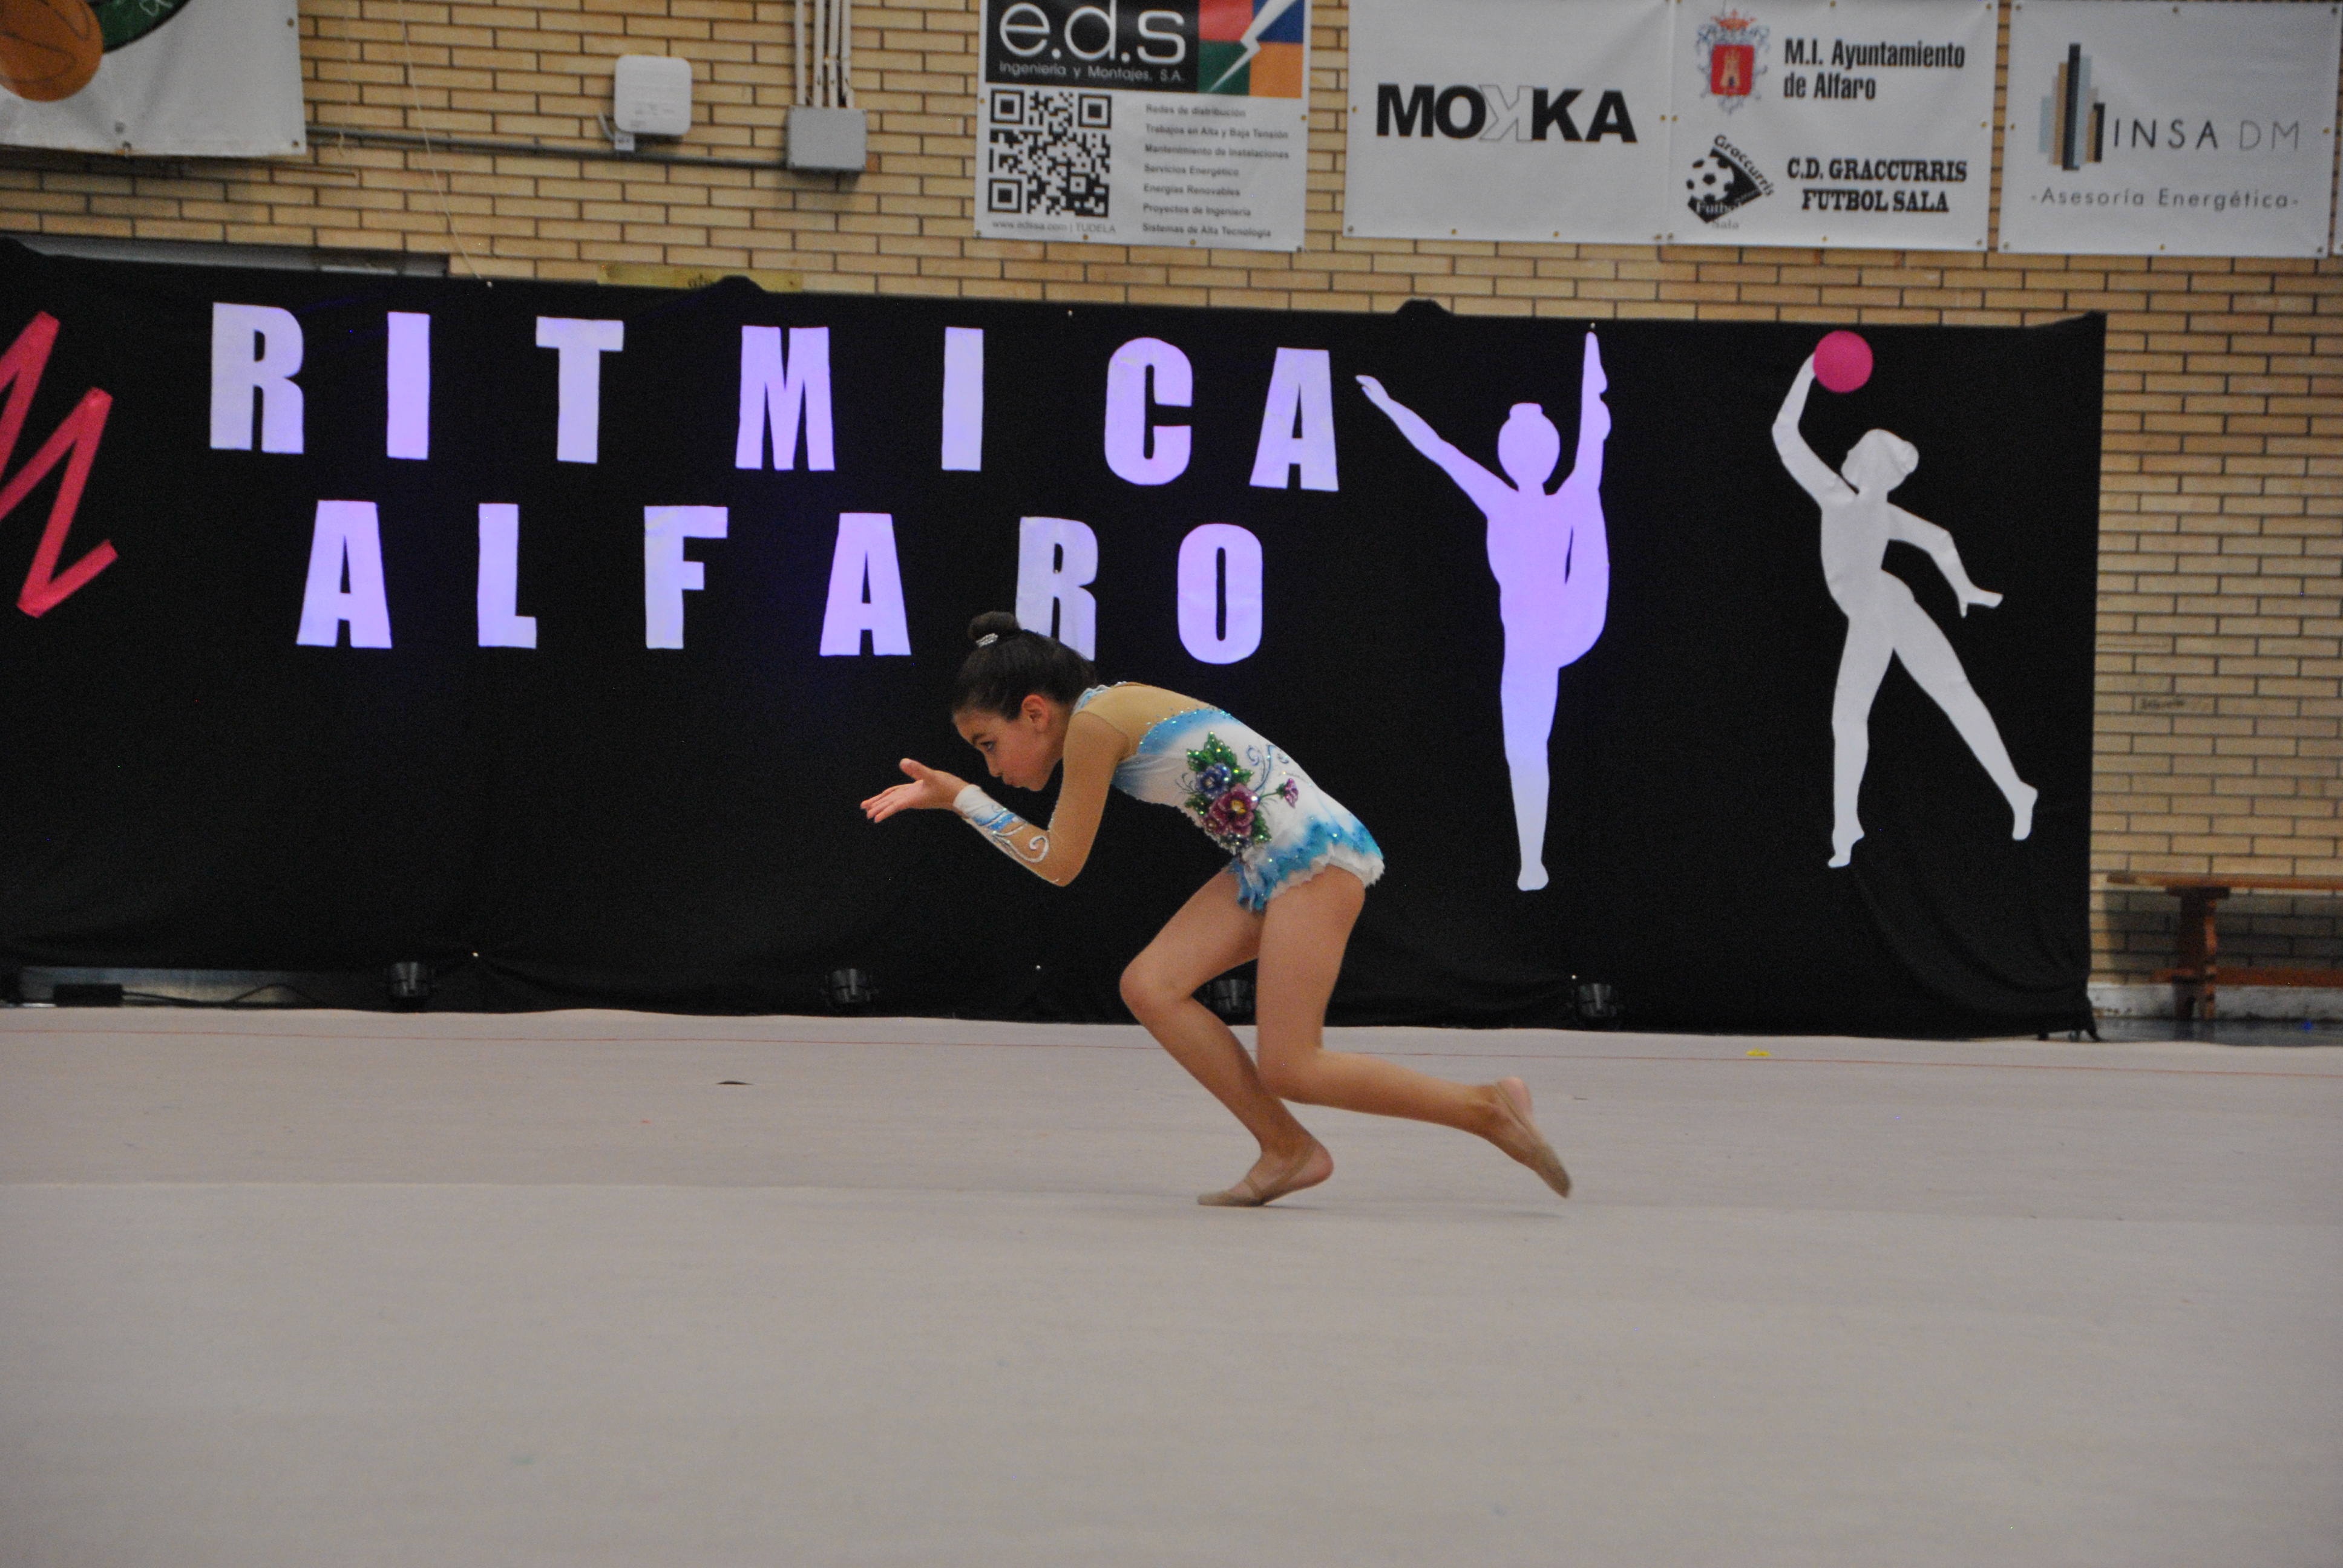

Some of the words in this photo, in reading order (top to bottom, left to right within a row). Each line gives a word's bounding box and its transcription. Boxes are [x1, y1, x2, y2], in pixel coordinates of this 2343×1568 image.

[1000, 0, 1186, 64] e.d.s
[1785, 38, 1823, 65] M.I.
[1831, 39, 1965, 70] Ayuntamiento
[1073, 66, 1081, 80] y
[1784, 71, 1806, 99] de
[1814, 71, 1876, 100] Alfaro
[1178, 105, 1188, 115] de
[1200, 126, 1219, 136] Alta
[2114, 118, 2219, 151] INSA
[2240, 120, 2299, 151] DM
[1787, 156, 1823, 180] C.D.
[1829, 157, 1967, 183] GRACCURRIS
[1191, 204, 1204, 214] de
[1801, 188, 1889, 212] FUTBOL
[1892, 190, 1950, 214] SALA
[1075, 222, 1116, 234] TUDELA
[1187, 224, 1199, 234] de
[1200, 224, 1219, 235] Alta
[210, 301, 1339, 492] RITMICA
[296, 499, 1263, 664] ALFARO
